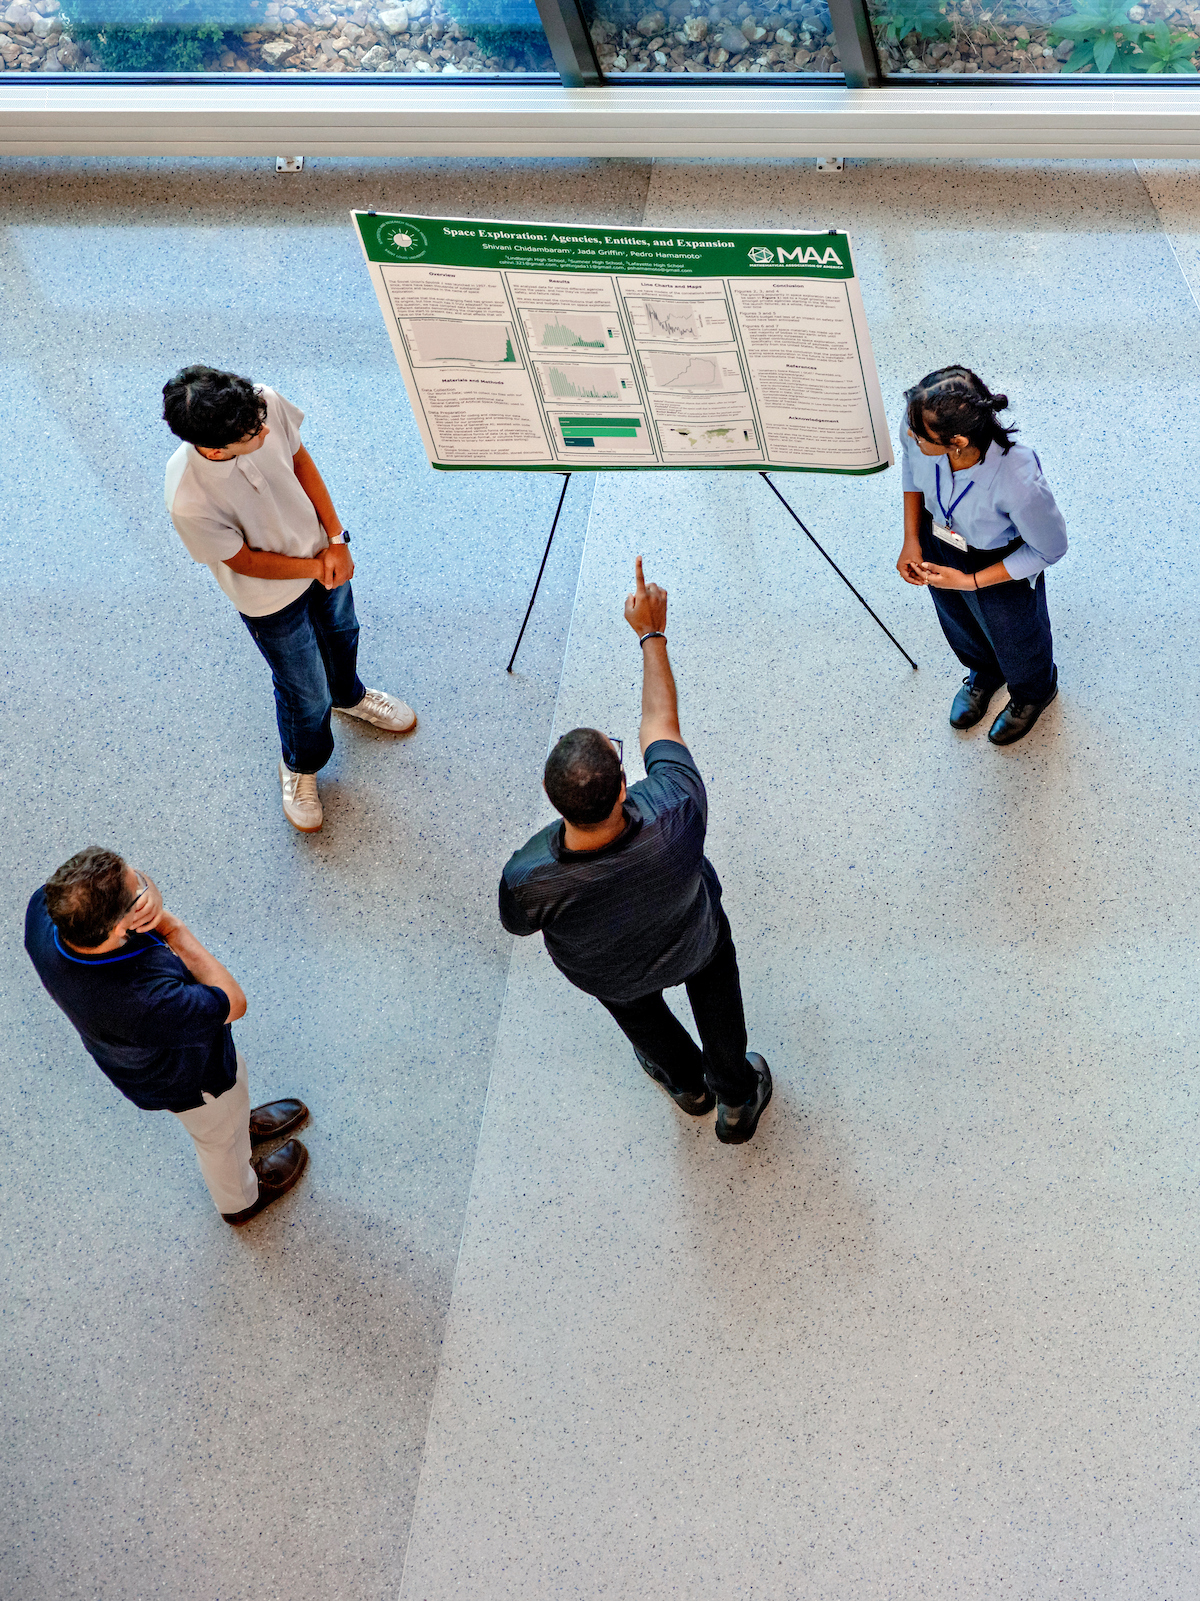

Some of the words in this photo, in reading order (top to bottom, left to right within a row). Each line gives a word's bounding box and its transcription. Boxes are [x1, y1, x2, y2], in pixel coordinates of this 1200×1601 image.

[443, 227, 475, 238] Space
[478, 229, 548, 241] Exploration:
[551, 234, 602, 244] Agencies,
[604, 236, 650, 247] Entities,
[653, 239, 673, 247] and
[677, 239, 735, 249] Expansion
[482, 243, 512, 251] Shivani
[776, 247, 843, 265] MAA
